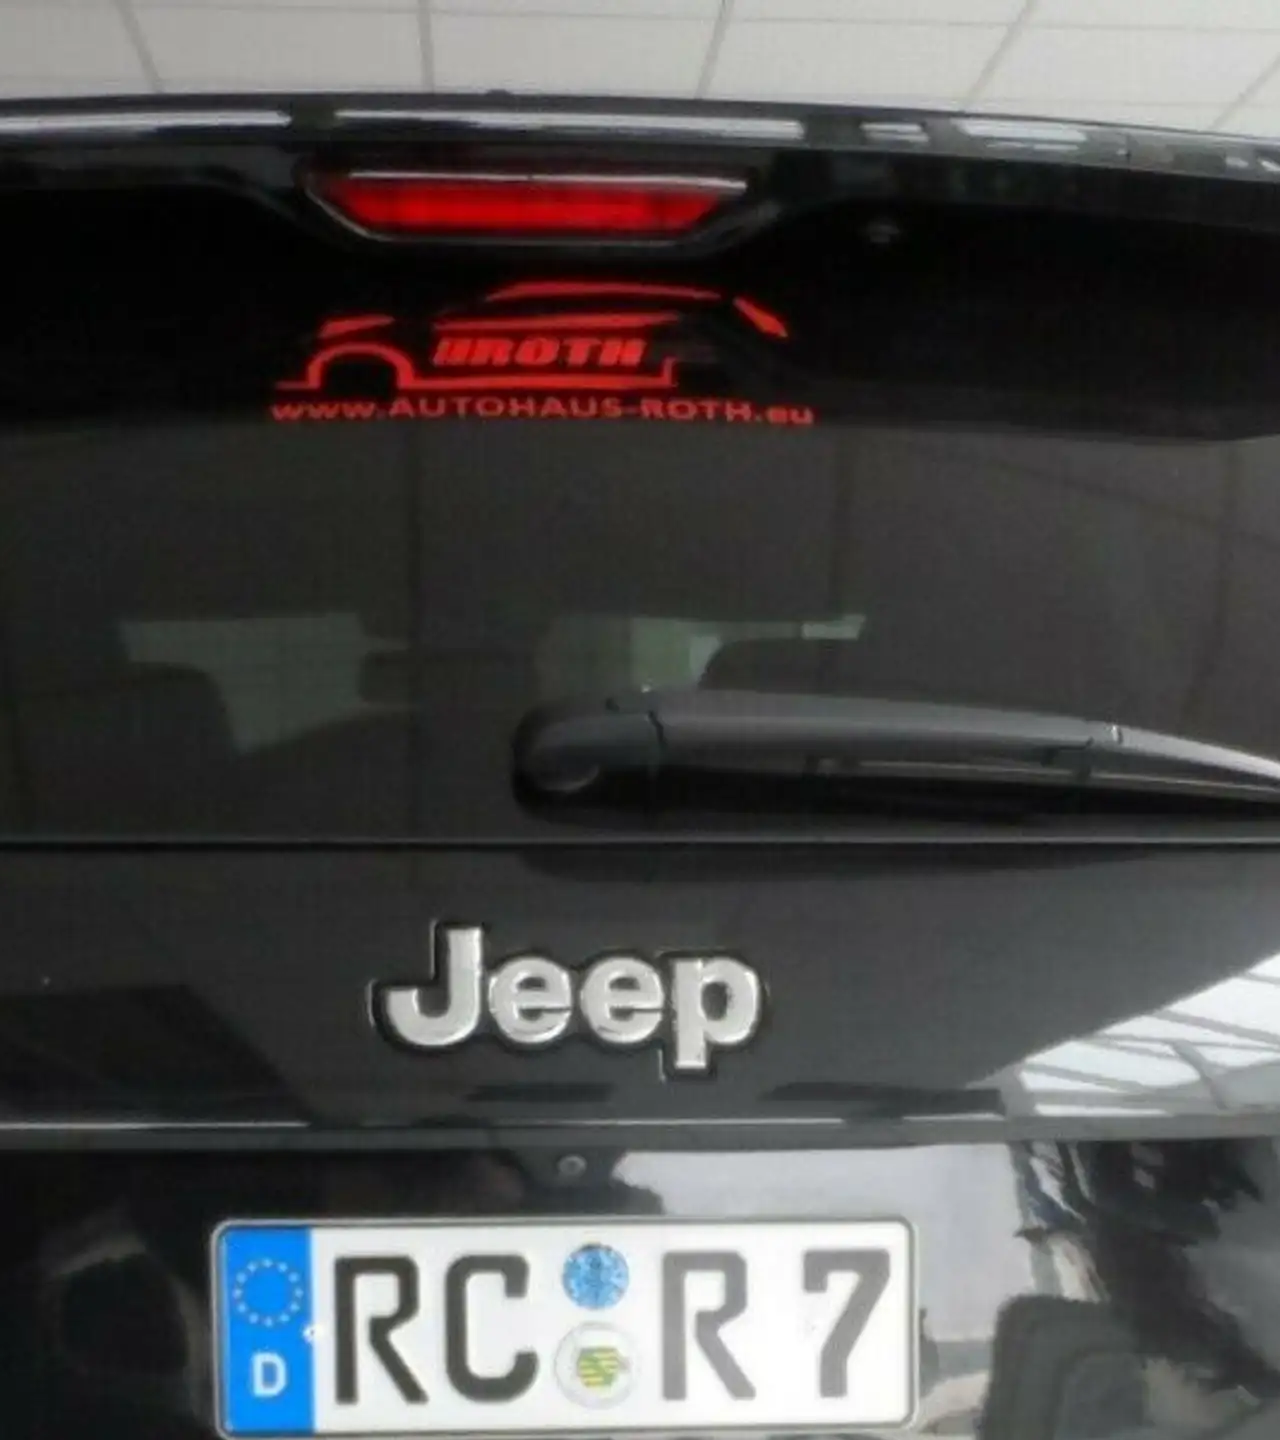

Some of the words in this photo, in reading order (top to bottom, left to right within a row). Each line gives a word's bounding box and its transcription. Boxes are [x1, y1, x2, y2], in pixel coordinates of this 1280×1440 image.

[377, 922, 763, 1072] Jeep
[251, 1352, 288, 1398] D
[333, 1254, 539, 1404] RC
[661, 1250, 756, 1400] R
[802, 1249, 891, 1399] 7
